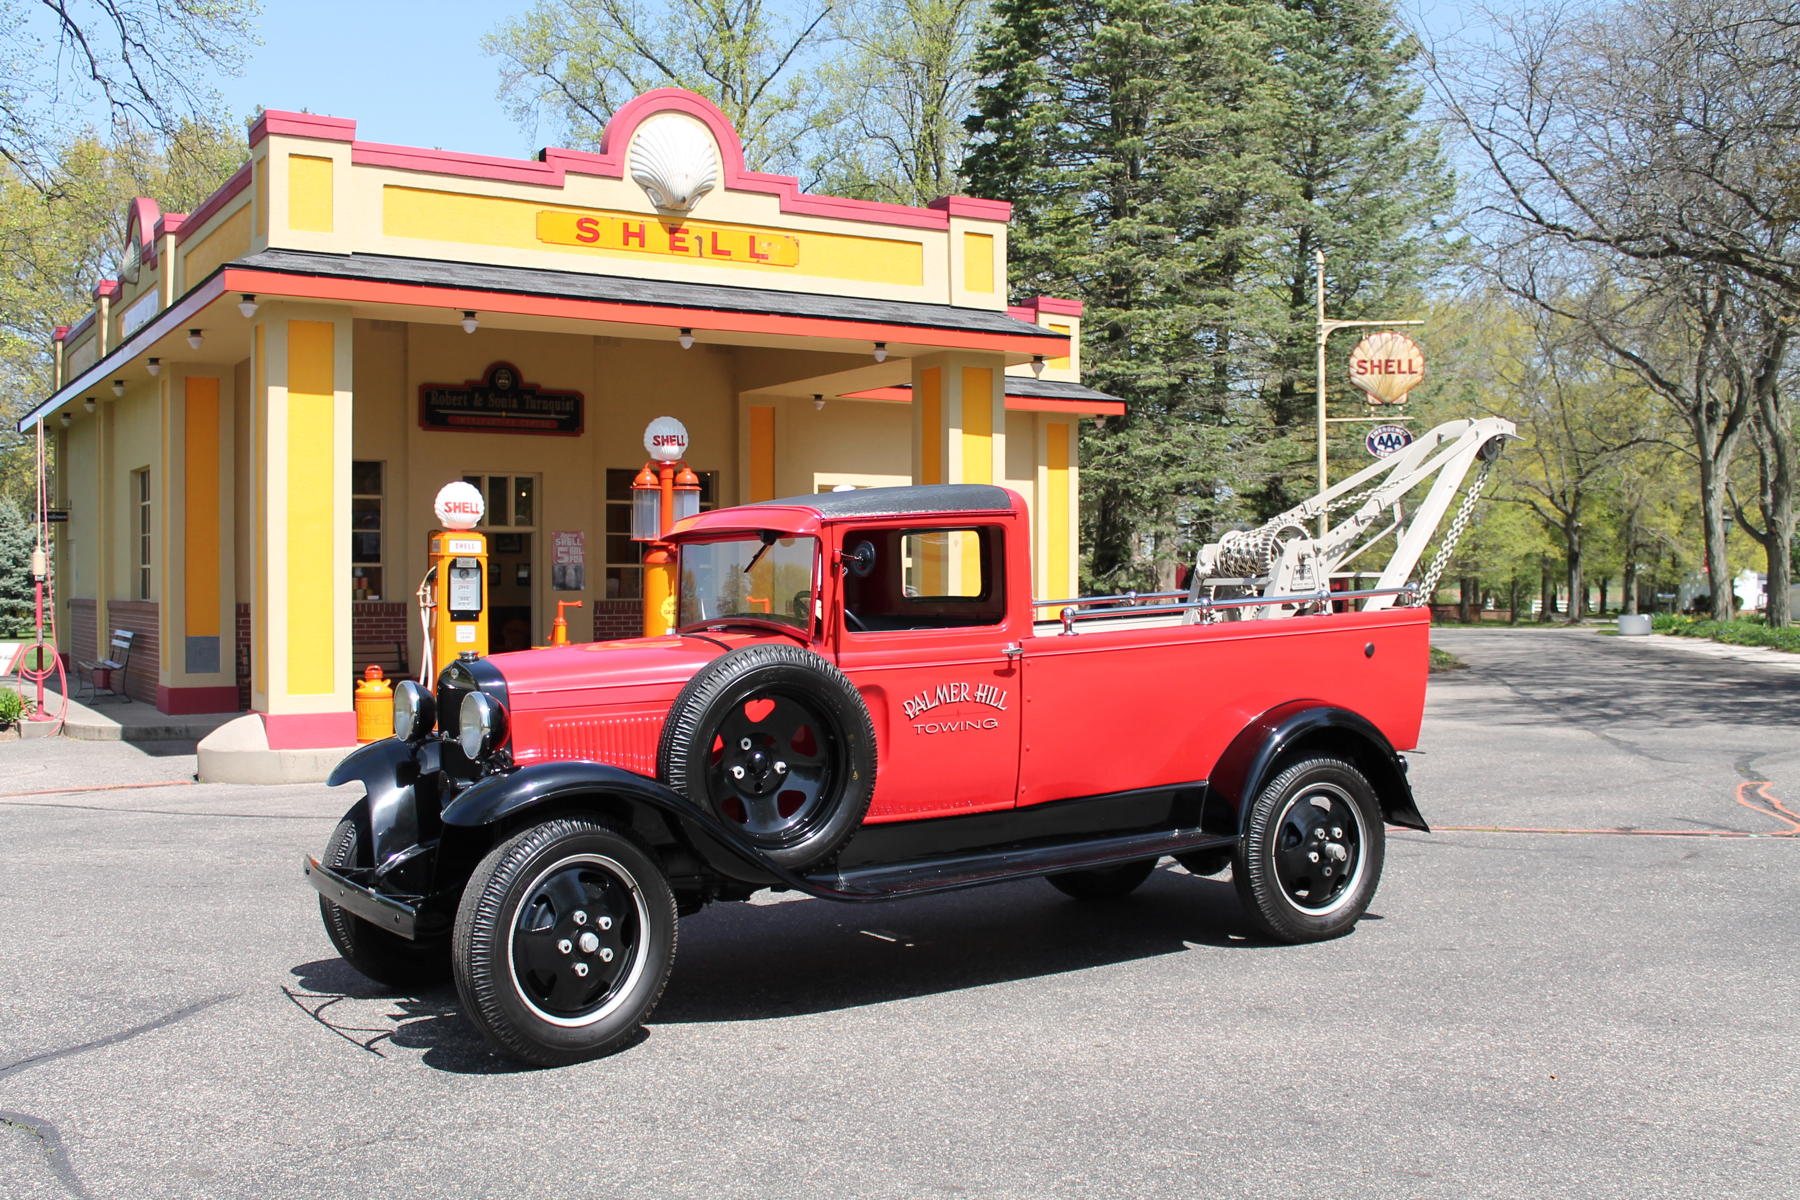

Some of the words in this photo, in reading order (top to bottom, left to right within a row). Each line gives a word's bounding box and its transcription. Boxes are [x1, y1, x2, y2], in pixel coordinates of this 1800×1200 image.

[576, 217, 769, 260] SHELL
[1356, 359, 1418, 375] SHELL
[430, 390, 468, 406] Robert
[652, 434, 686, 447] SHELL
[1377, 433, 1402, 450] AAA
[444, 501, 480, 514] SHELL
[555, 537, 582, 546] SHELL
[557, 546, 570, 564] 5
[902, 682, 972, 720] PALMER
[974, 682, 1008, 711] HILL
[913, 718, 999, 735] TOWING
